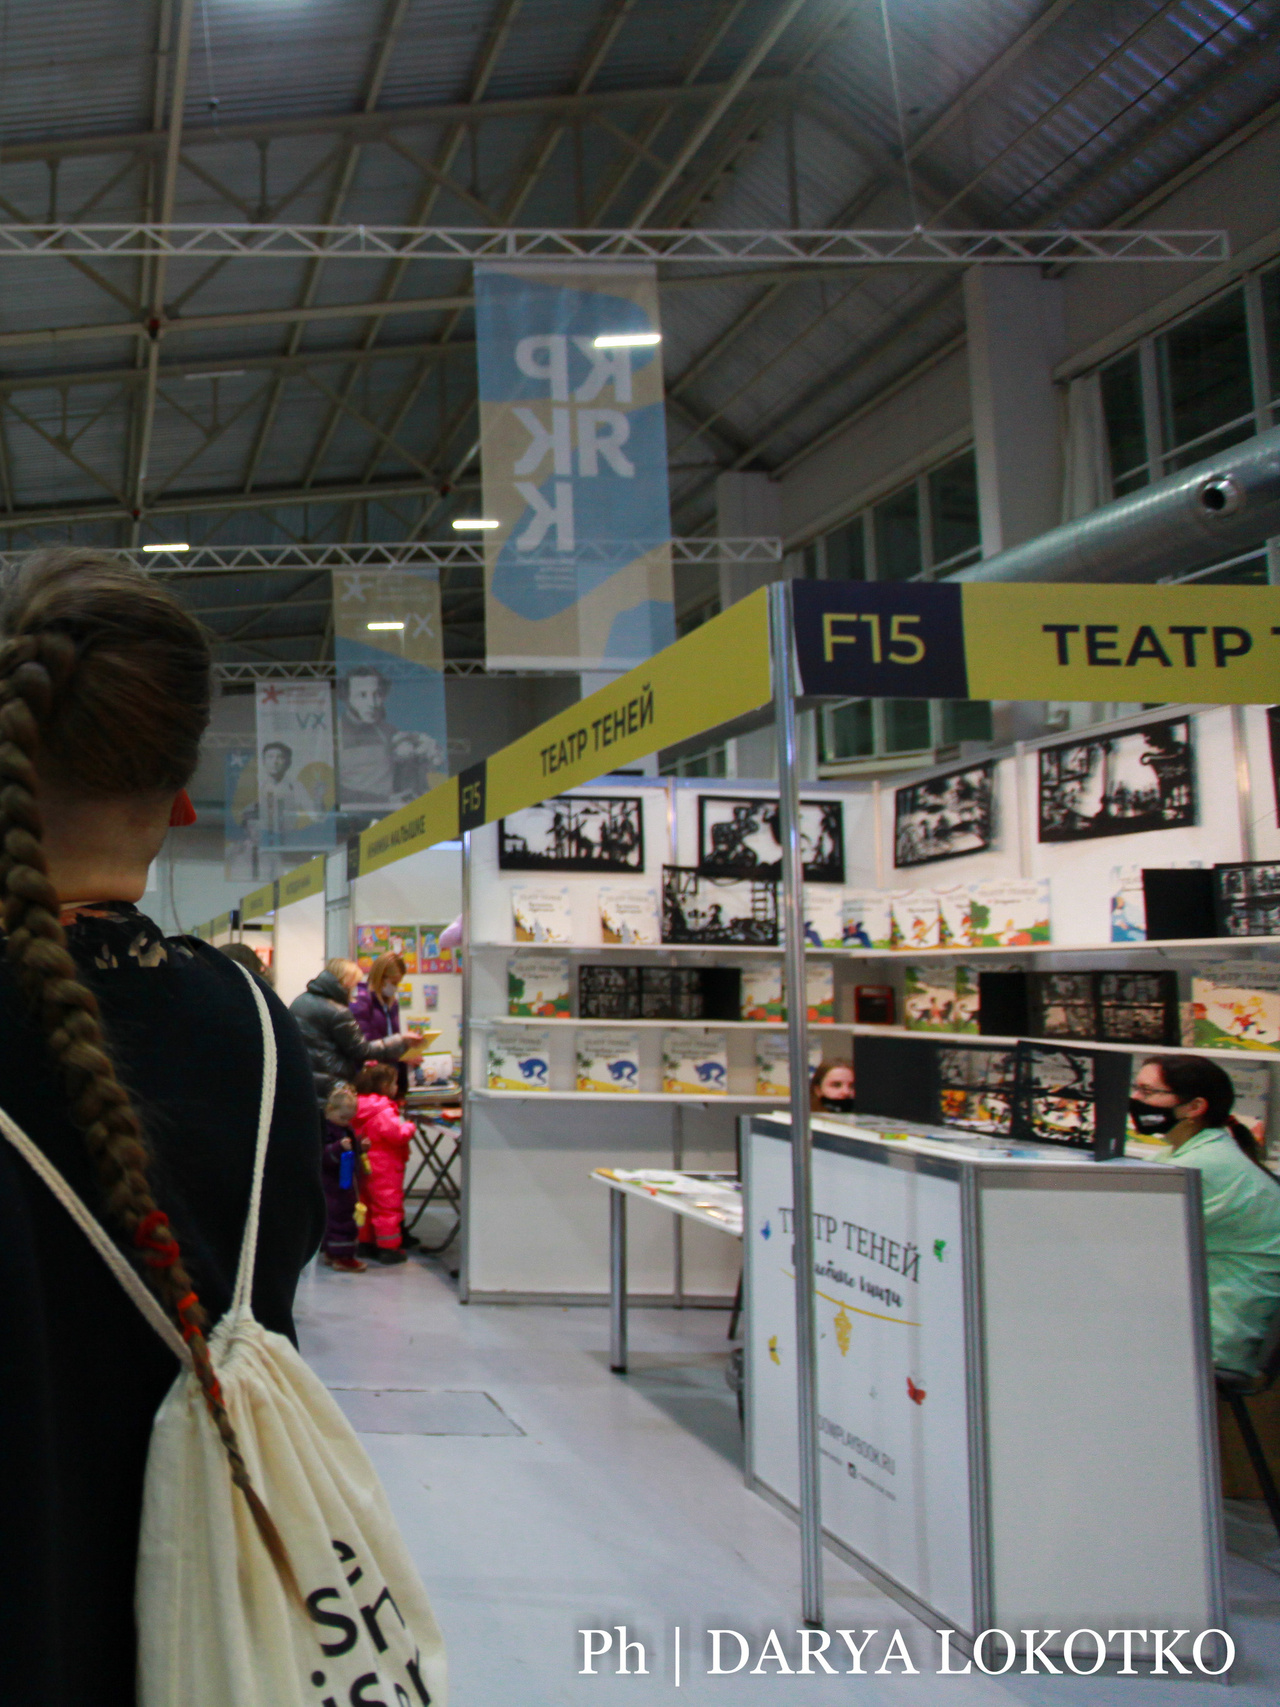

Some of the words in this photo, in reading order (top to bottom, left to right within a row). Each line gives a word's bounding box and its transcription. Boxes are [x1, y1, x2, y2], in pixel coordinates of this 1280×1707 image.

[822, 612, 926, 664] F15
[1042, 624, 1253, 668] ТЕАТР
[540, 723, 588, 777] ТЕАТР
[593, 682, 656, 756] ТЕНЕЙ
[778, 1207, 838, 1243] ТТР
[843, 1221, 921, 1284] ТЕНЕЙ
